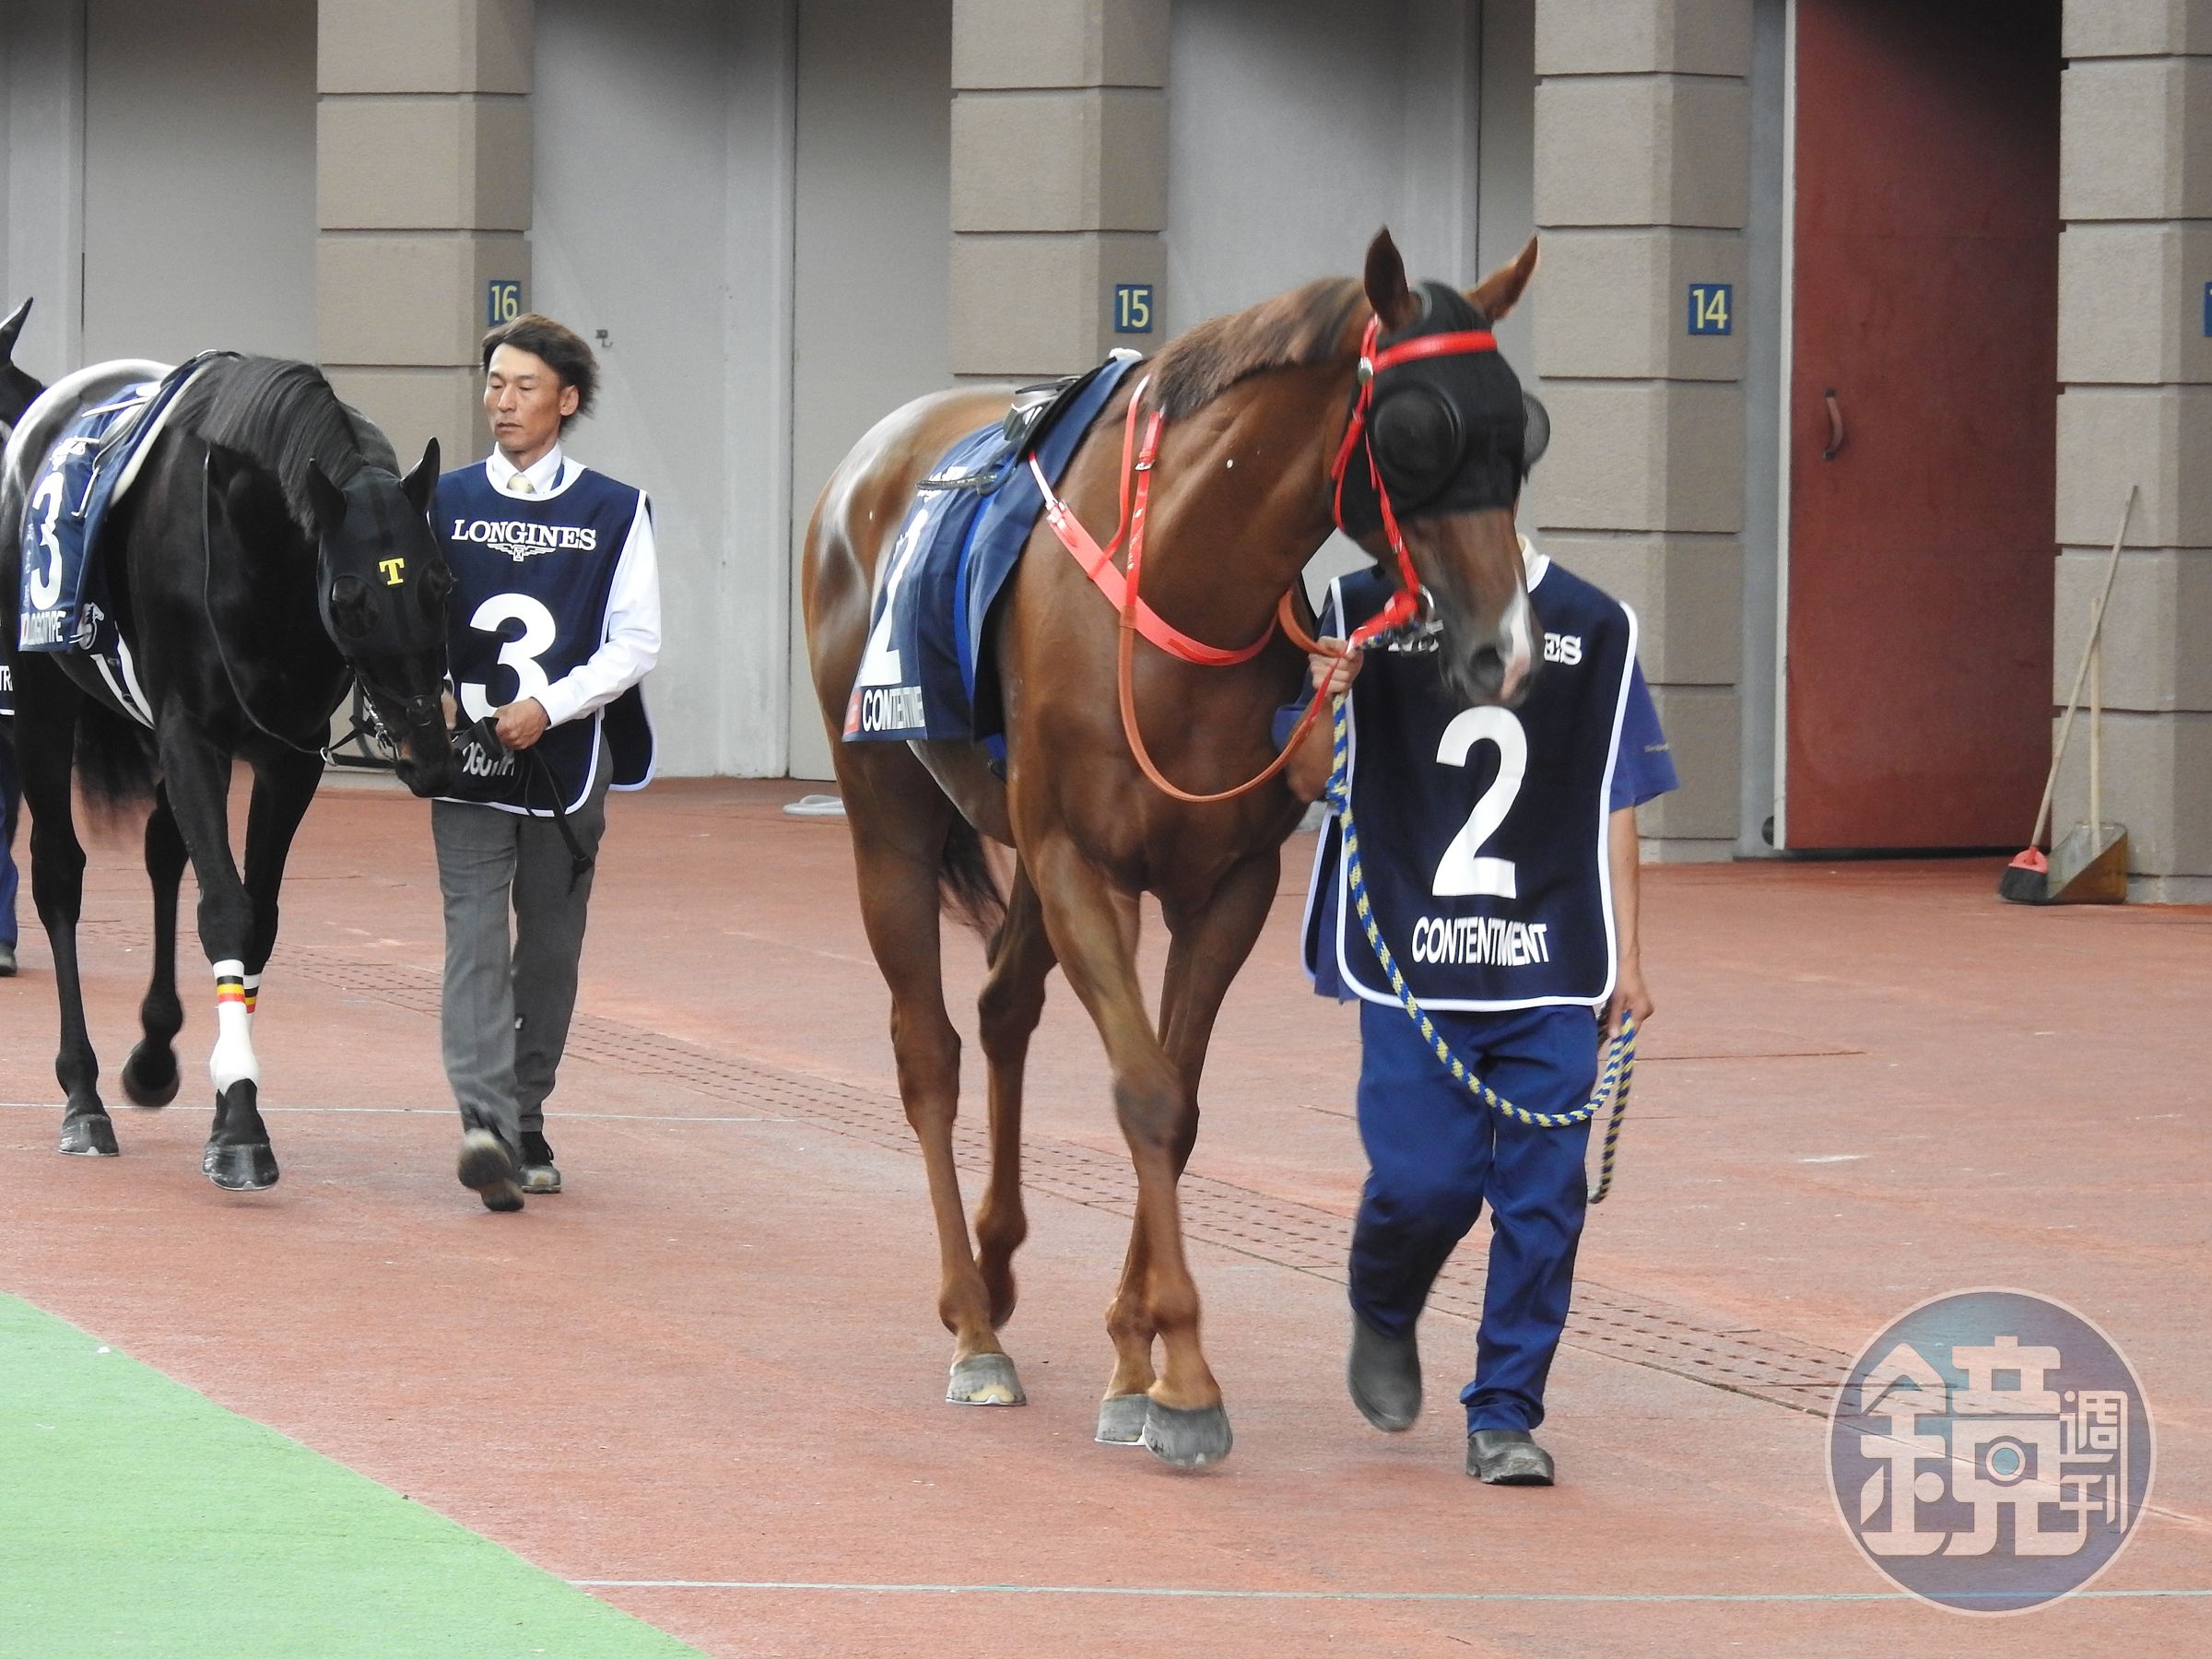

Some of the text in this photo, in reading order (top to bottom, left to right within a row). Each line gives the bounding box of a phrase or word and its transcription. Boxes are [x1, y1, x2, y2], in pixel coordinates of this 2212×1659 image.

[490, 285, 518, 323] 16
[1118, 288, 1149, 328] 15
[1692, 288, 1728, 329] 14
[30, 471, 65, 611] 3
[451, 519, 597, 551] LONGINES
[379, 558, 405, 586] T
[460, 592, 558, 724] 3
[1432, 705, 1527, 900] 2
[1411, 916, 1550, 967] CONTENTMENT
